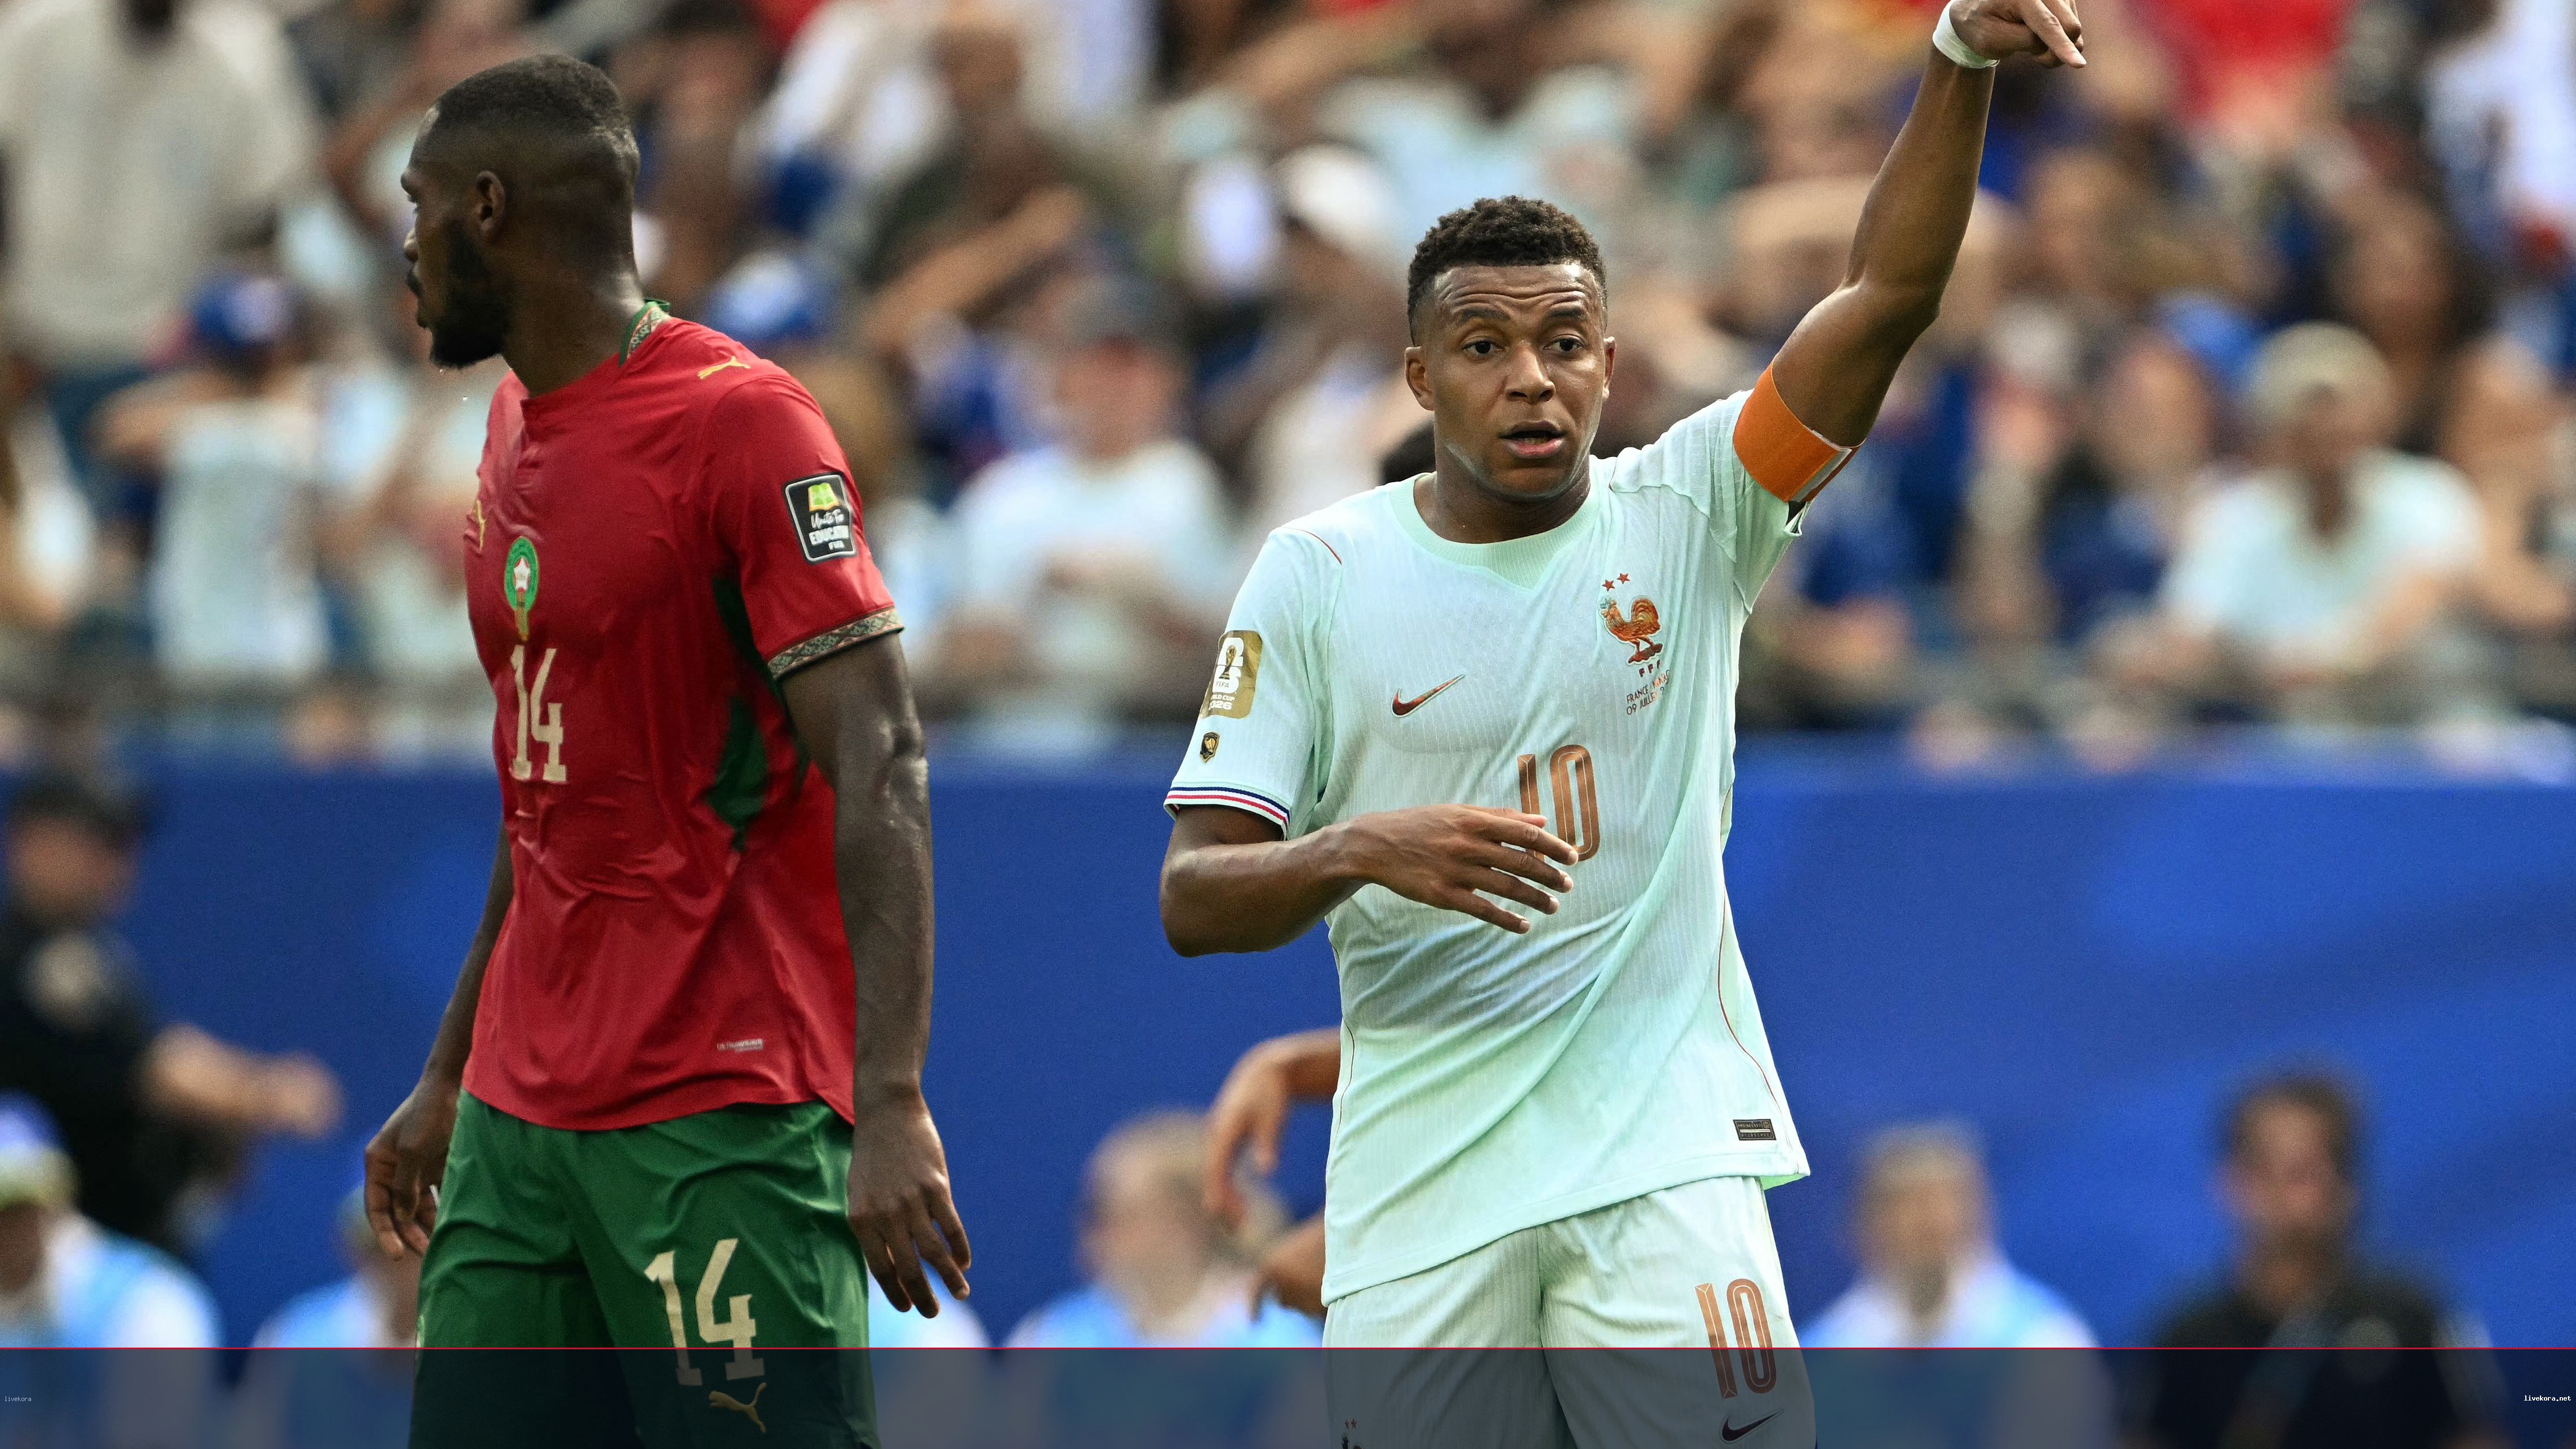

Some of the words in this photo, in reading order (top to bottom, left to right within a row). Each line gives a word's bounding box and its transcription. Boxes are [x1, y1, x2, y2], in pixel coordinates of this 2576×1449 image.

[510, 645, 566, 781] 14
[1208, 700, 1233, 710] 026
[1626, 685, 1649, 704] FRANCE
[1627, 703, 1637, 715] 09
[1517, 744, 1600, 863] 10
[644, 1238, 765, 1386] 14
[1694, 1278, 1776, 1399] 10
